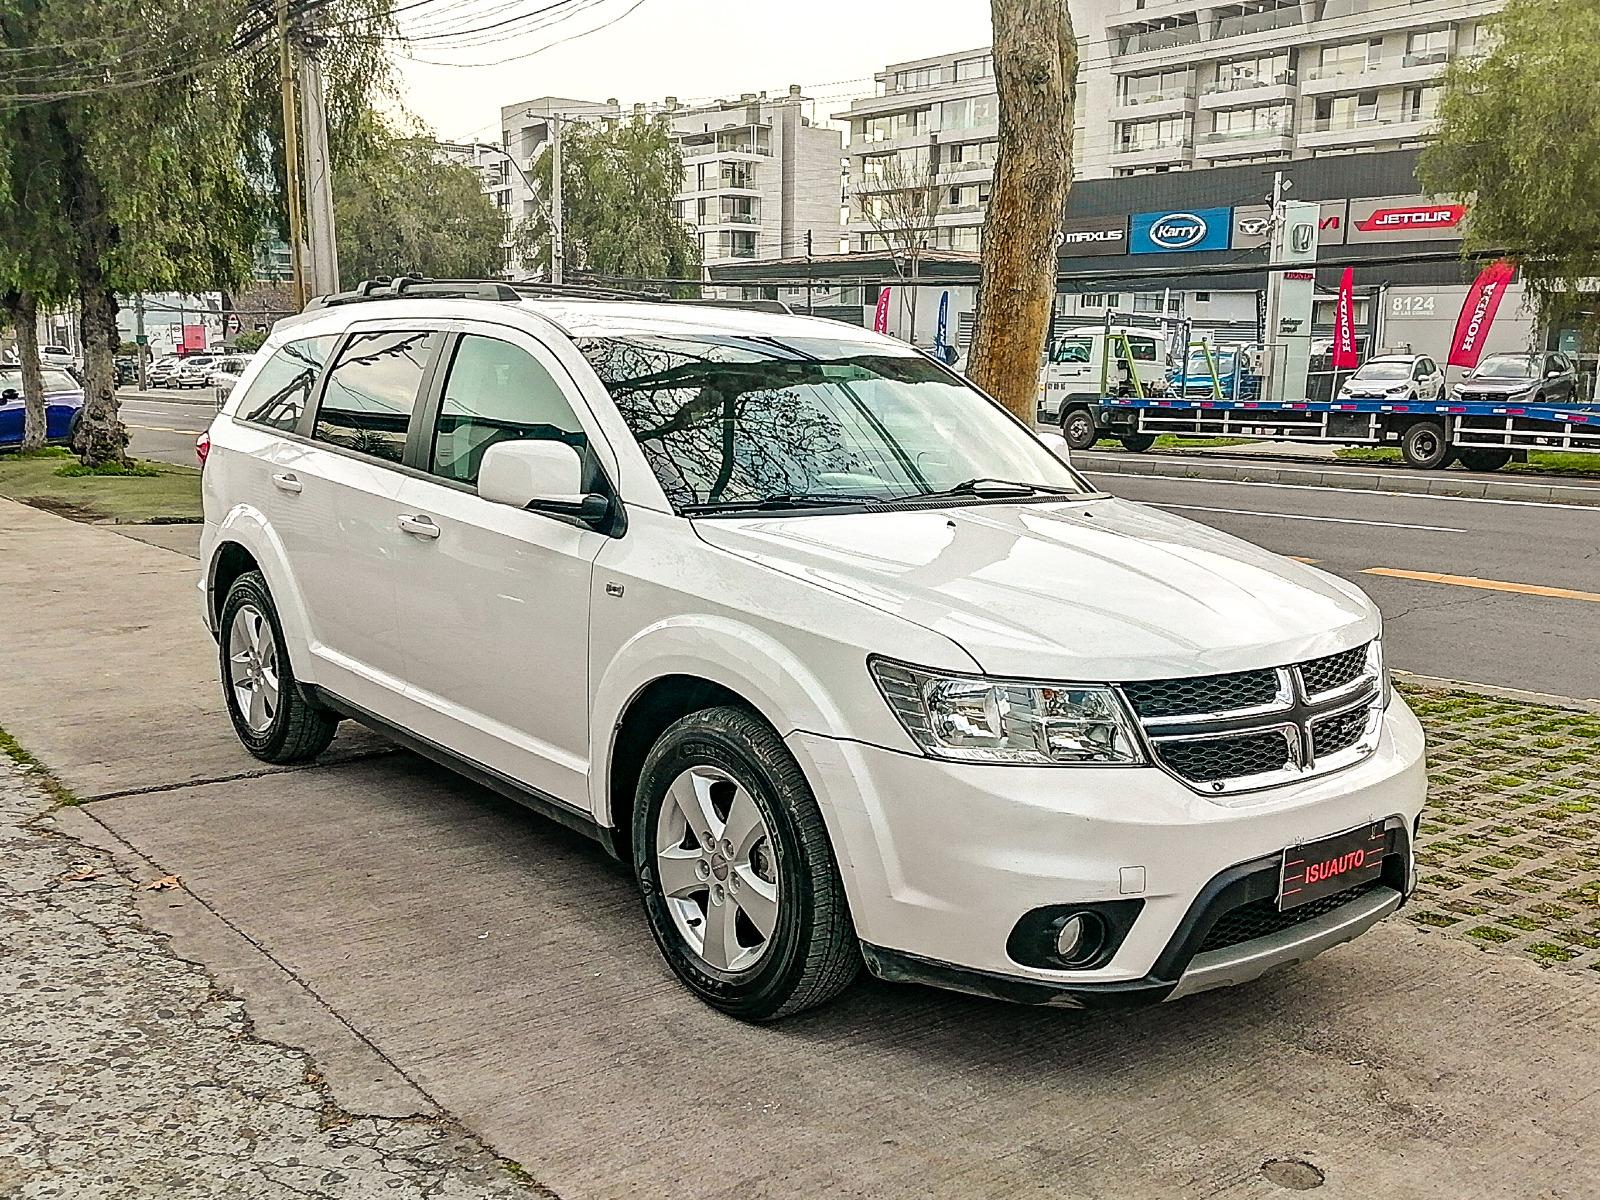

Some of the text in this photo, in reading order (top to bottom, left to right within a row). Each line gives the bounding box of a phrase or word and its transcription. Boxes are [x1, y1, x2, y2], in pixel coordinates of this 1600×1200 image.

[1375, 211, 1452, 225] JETOUR
[1066, 229, 1123, 243] MAXUS
[1157, 225, 1199, 239] Karry
[1392, 296, 1435, 311] 8124
[1340, 288, 1352, 352] HONDA
[1461, 281, 1498, 352] HONDA
[1304, 849, 1365, 884] ISUAUTO
